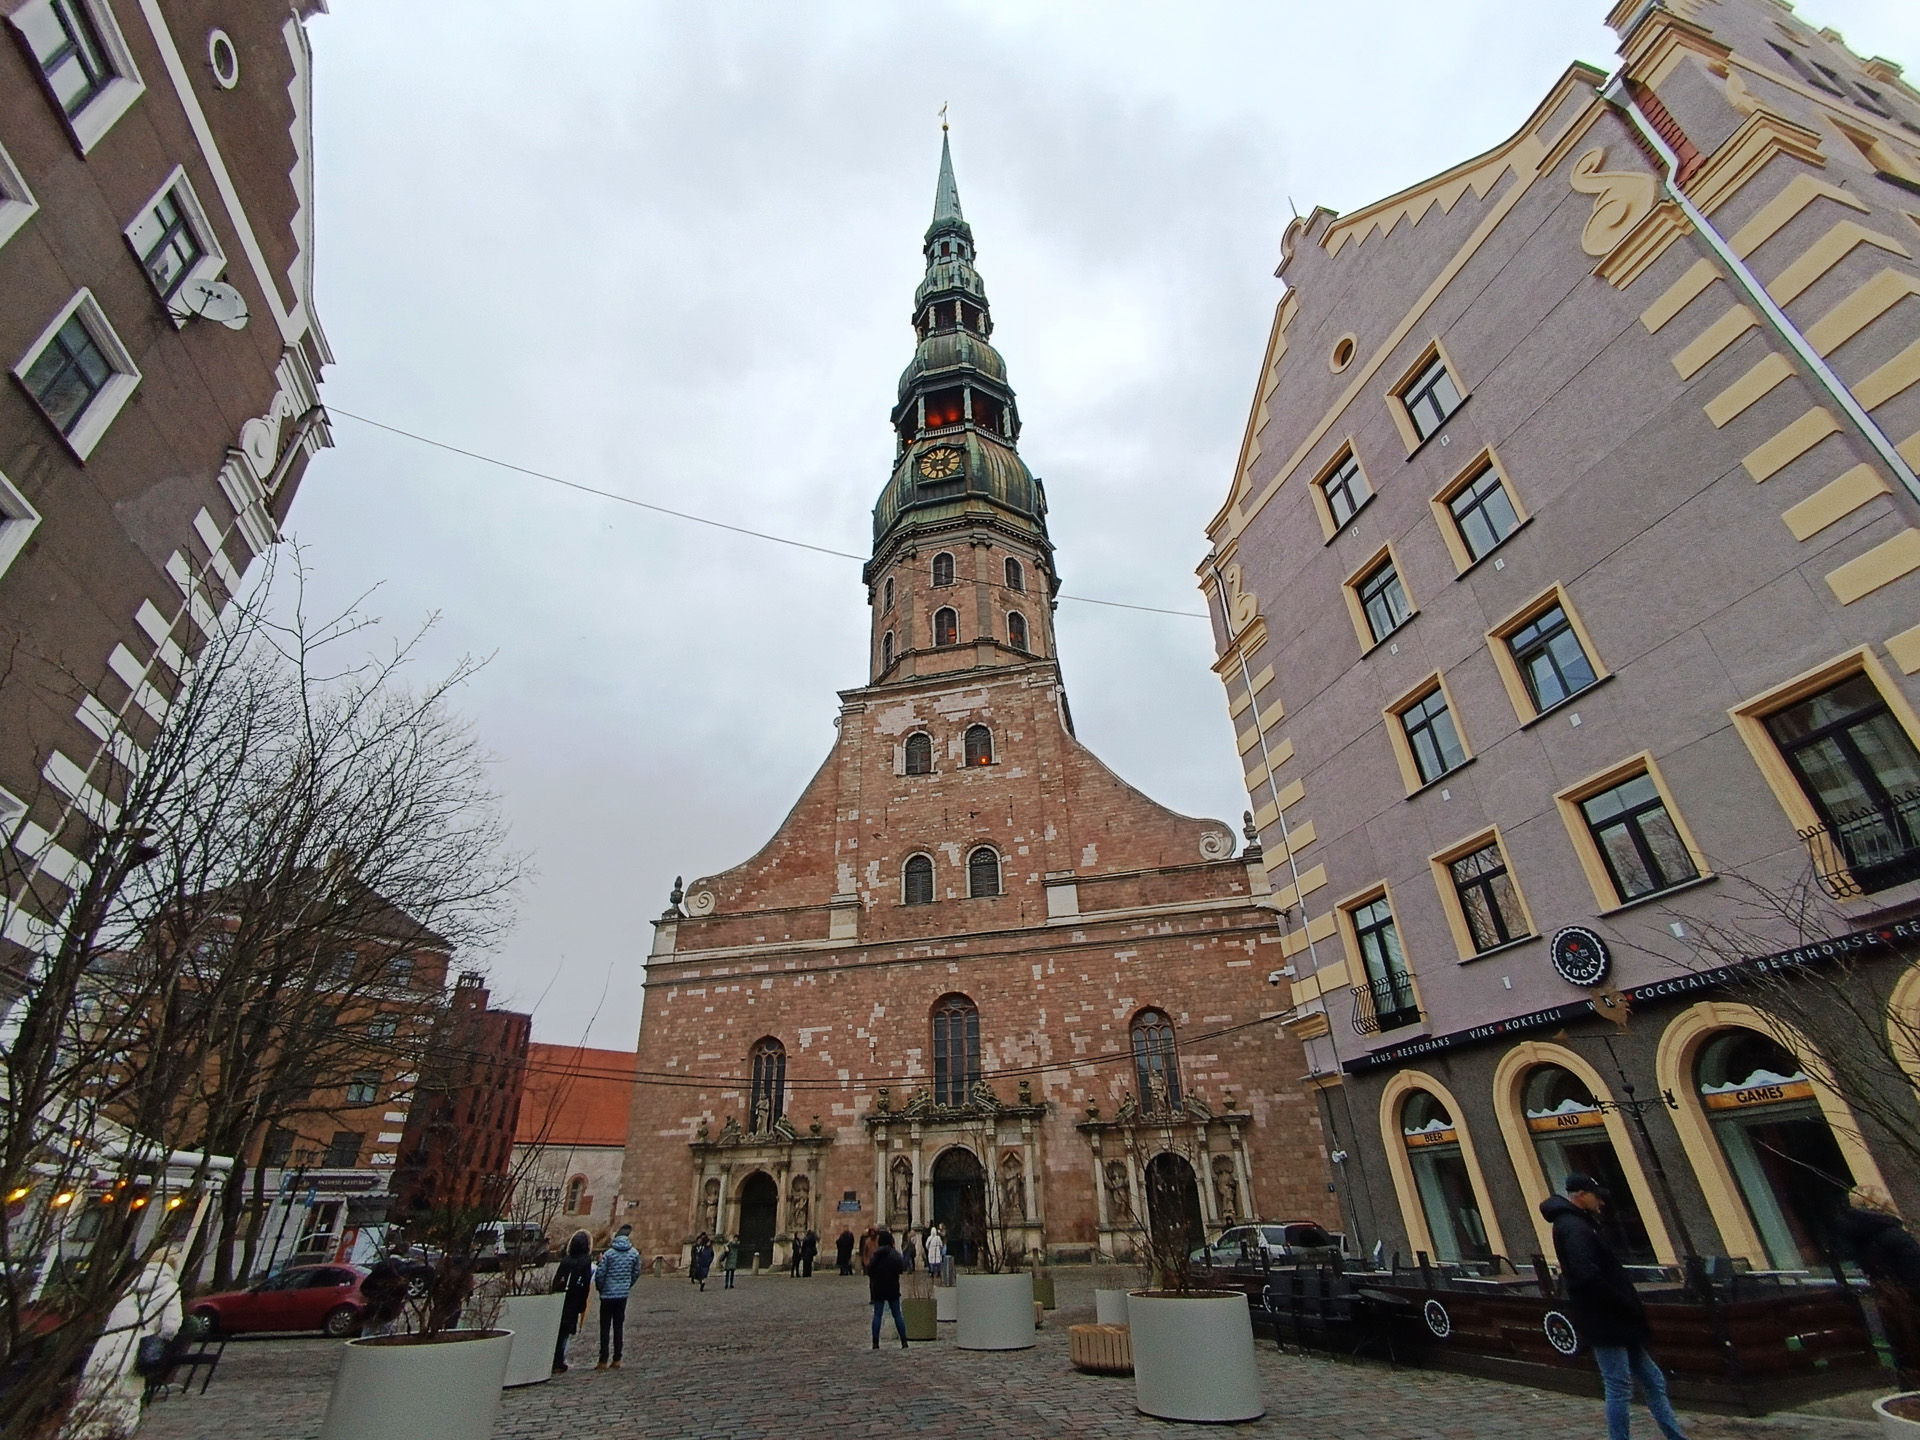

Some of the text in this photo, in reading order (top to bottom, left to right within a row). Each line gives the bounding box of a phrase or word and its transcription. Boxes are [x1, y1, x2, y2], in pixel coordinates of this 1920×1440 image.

[1756, 932, 1877, 972] BEERHOUSE
[1565, 958, 1598, 977] LUCKY
[1635, 970, 1728, 1000] COCKTAILS
[1370, 1037, 1450, 1064] ALUS RESTORANS
[1736, 1086, 1783, 1103] GAMES
[1557, 1115, 1579, 1127] AND
[1424, 1133, 1443, 1142] BEER
